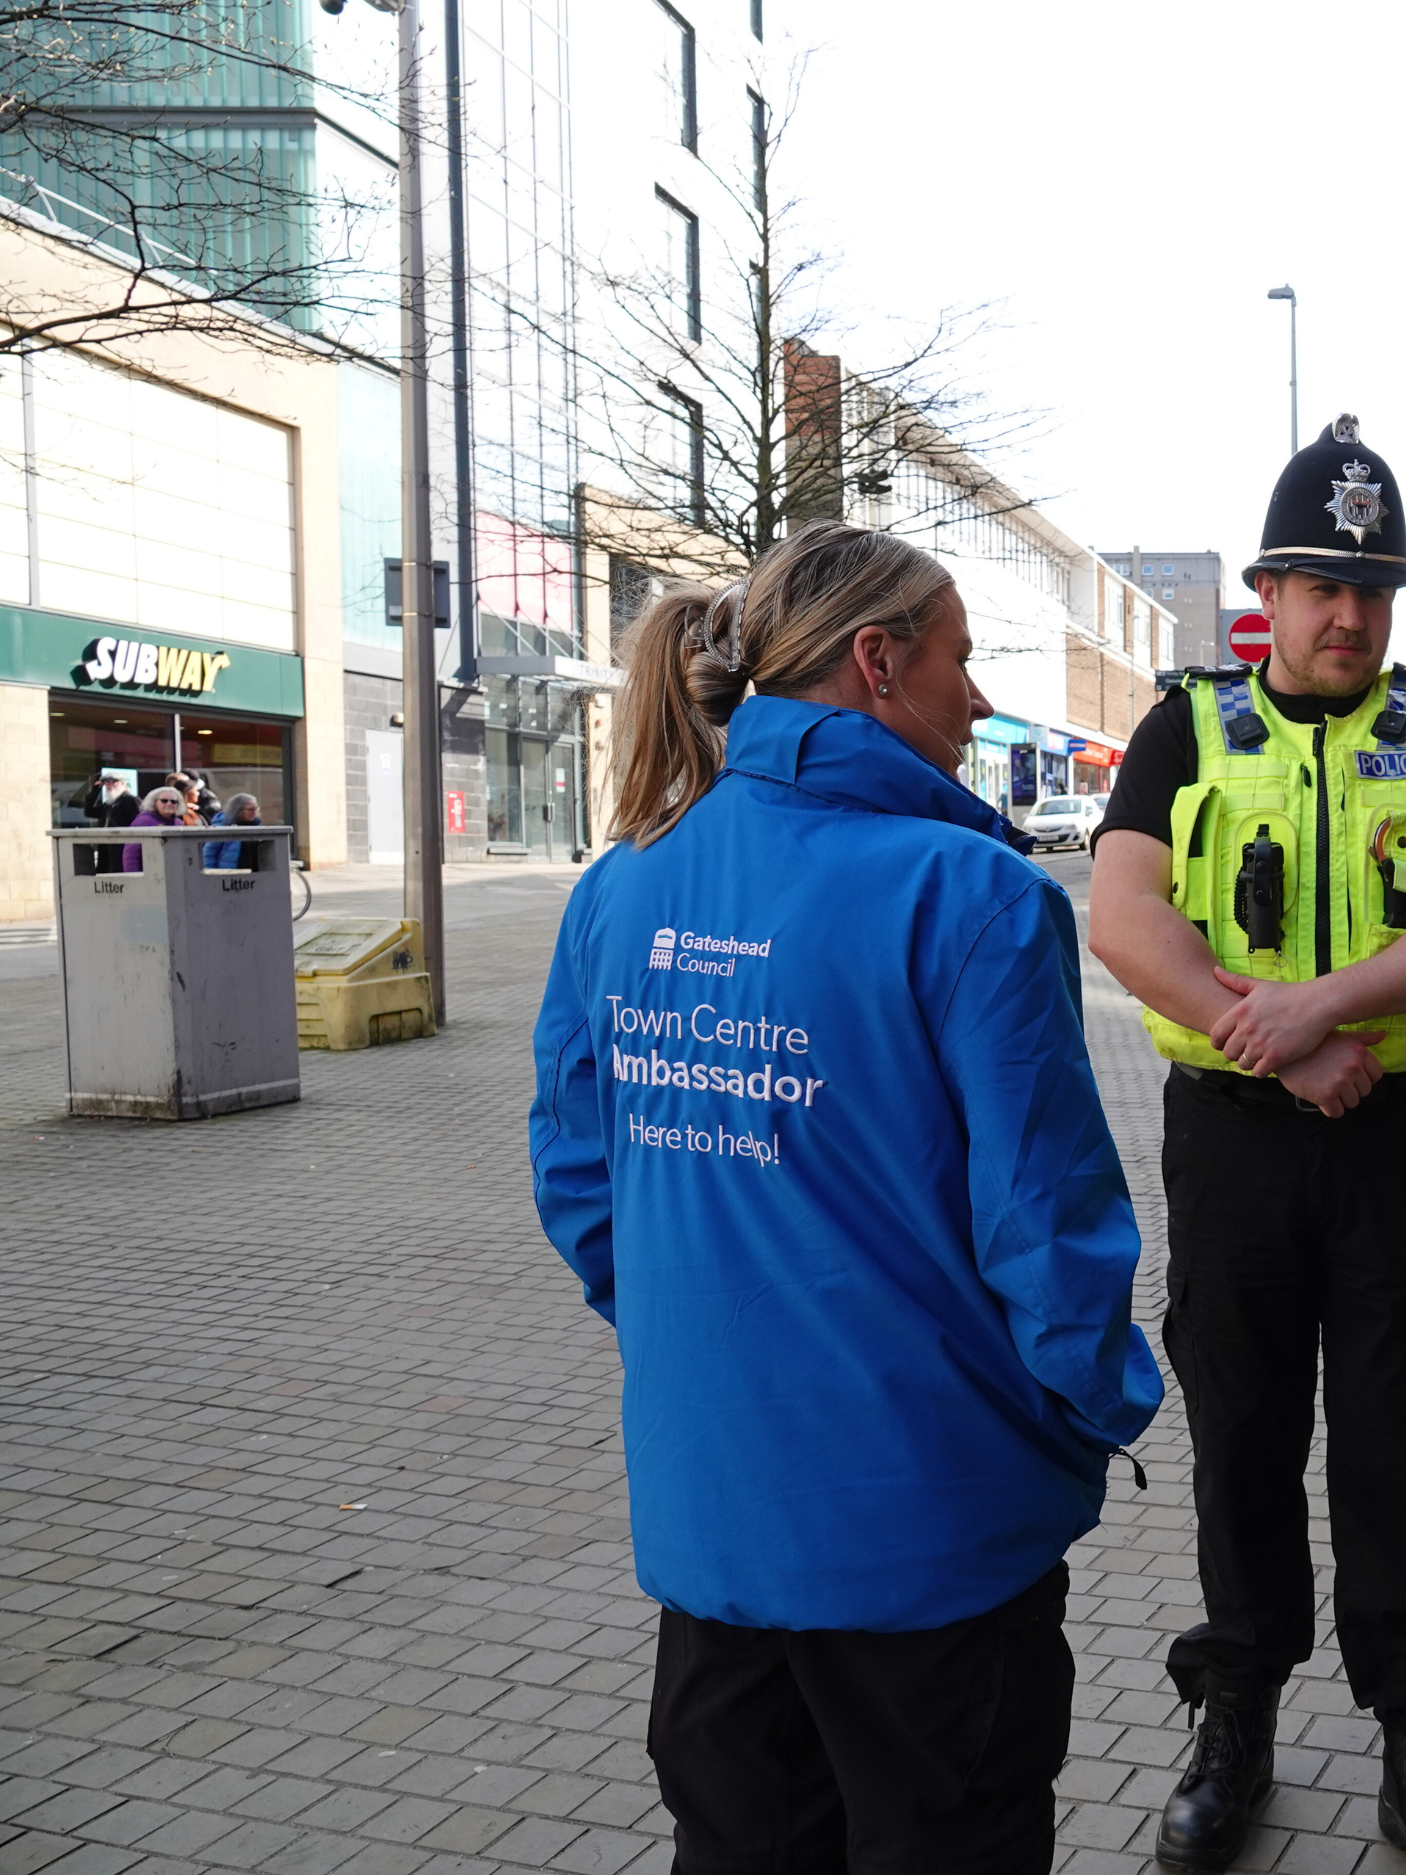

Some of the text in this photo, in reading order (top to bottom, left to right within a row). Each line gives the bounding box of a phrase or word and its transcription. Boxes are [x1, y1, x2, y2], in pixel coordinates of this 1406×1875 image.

[87, 637, 231, 693] SUBWAY
[94, 880, 125, 894] Litter
[222, 879, 255, 892] Litter
[676, 953, 736, 977] Council
[680, 932, 771, 958] Gateshead
[606, 995, 809, 1055] Town Centre
[613, 1043, 823, 1107] Ambassador
[629, 1113, 780, 1168] Here to help!
